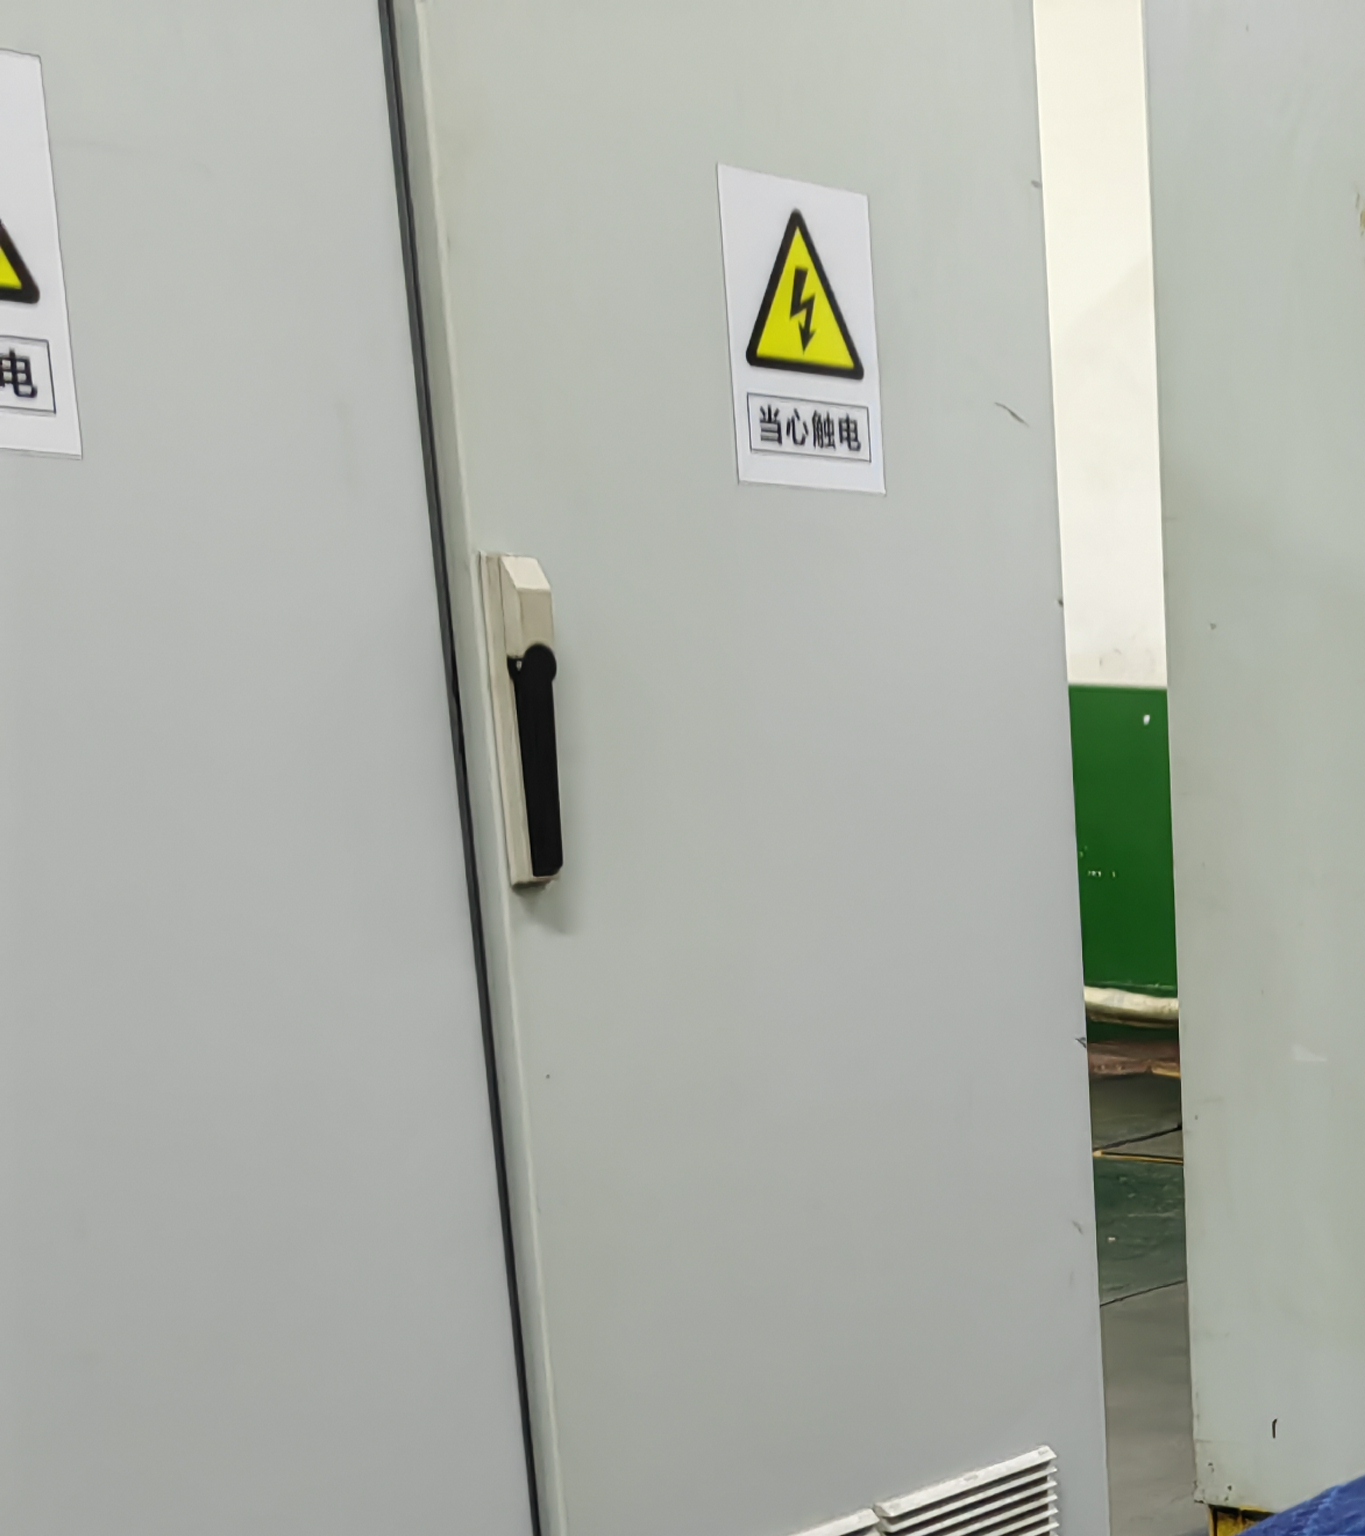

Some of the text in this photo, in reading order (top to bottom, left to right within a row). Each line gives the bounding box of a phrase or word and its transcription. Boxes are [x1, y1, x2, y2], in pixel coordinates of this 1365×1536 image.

[0, 348, 38, 399] 电
[760, 404, 861, 452] 当心触电
